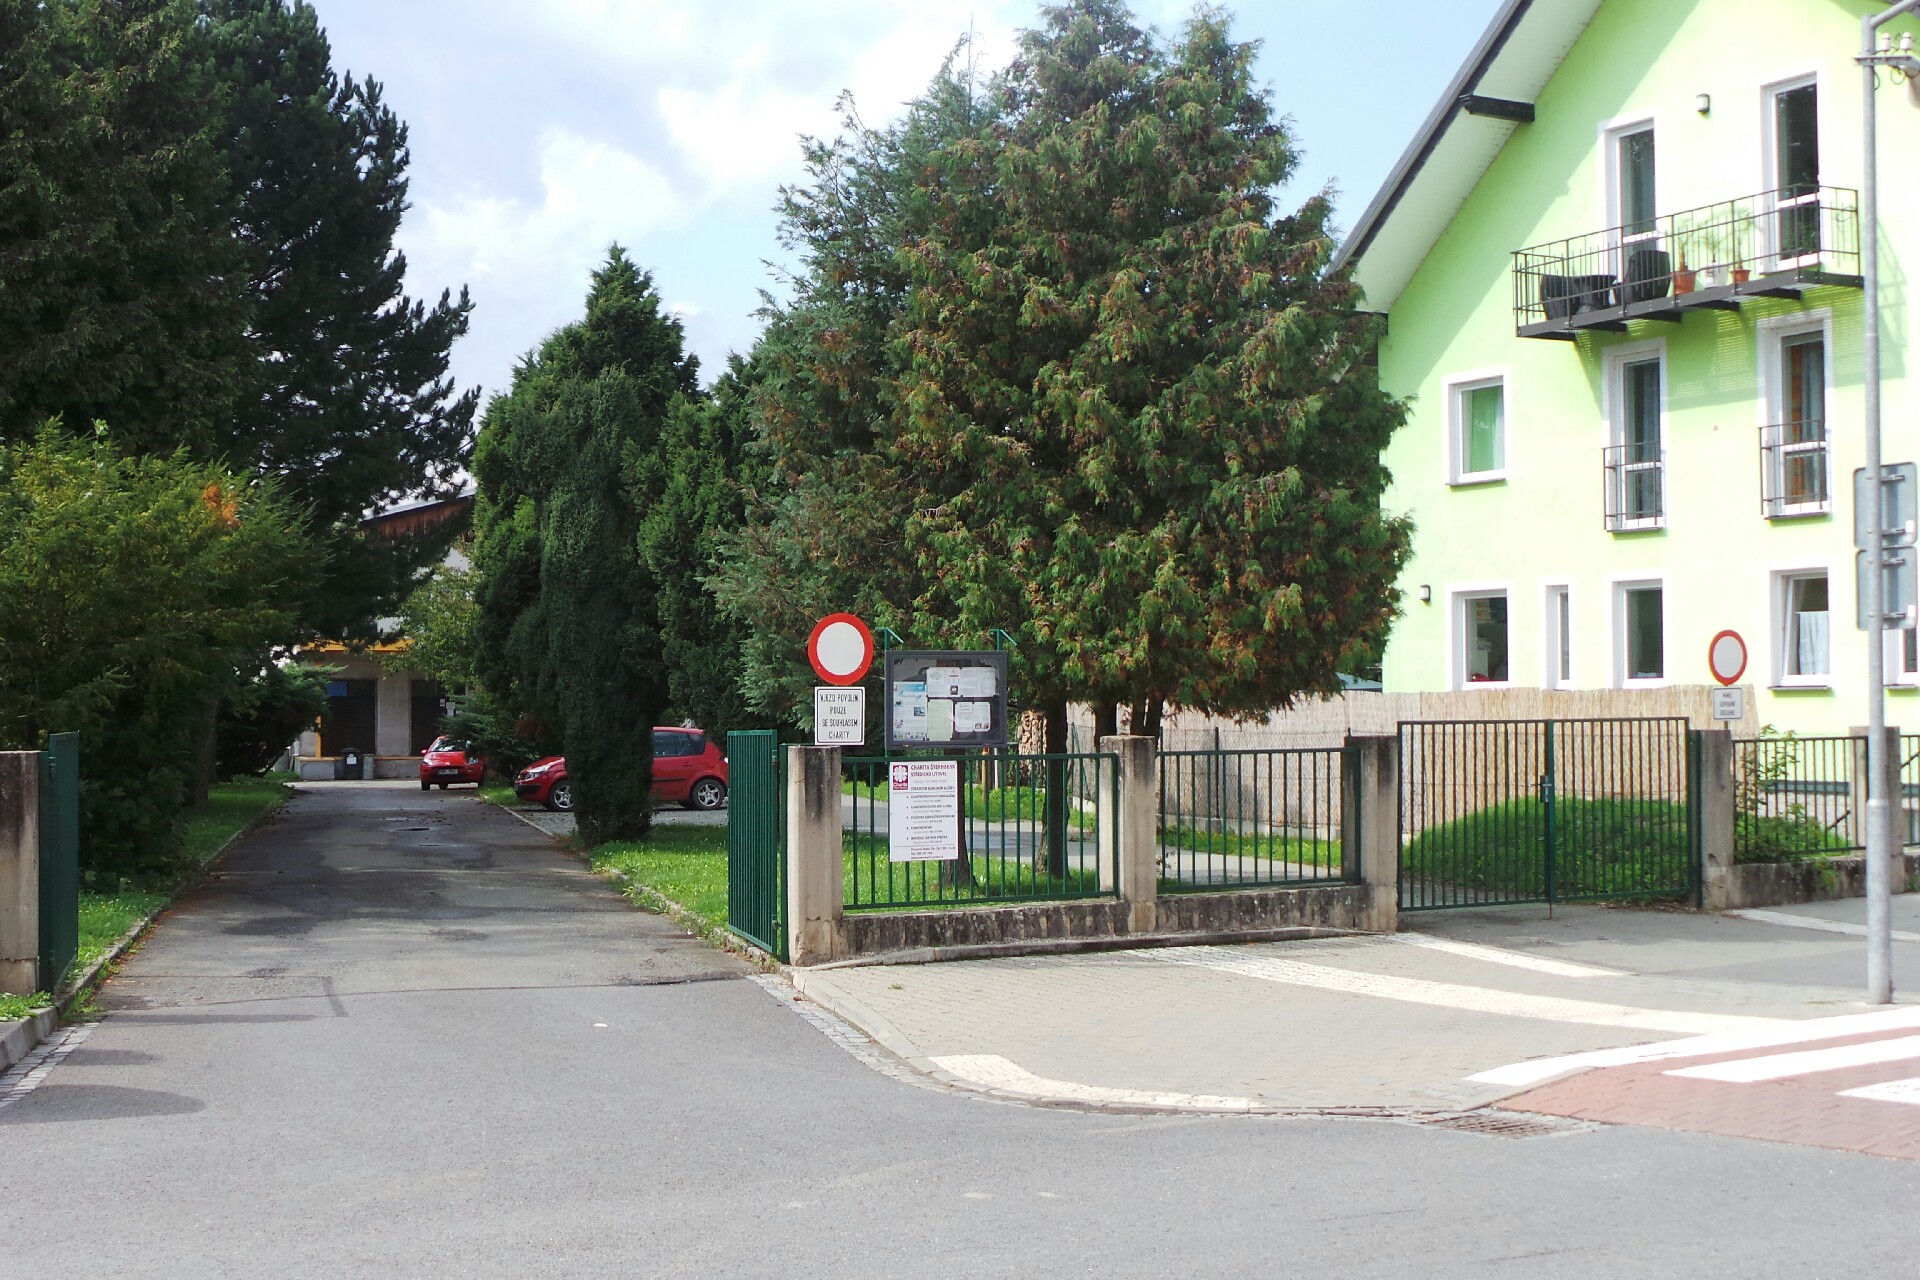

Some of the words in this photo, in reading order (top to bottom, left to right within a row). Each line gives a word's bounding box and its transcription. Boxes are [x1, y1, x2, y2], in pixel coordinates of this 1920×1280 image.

[830, 706, 847, 715] POUZE
[822, 718, 828, 727] SE
[828, 730, 850, 739] CHARITY
